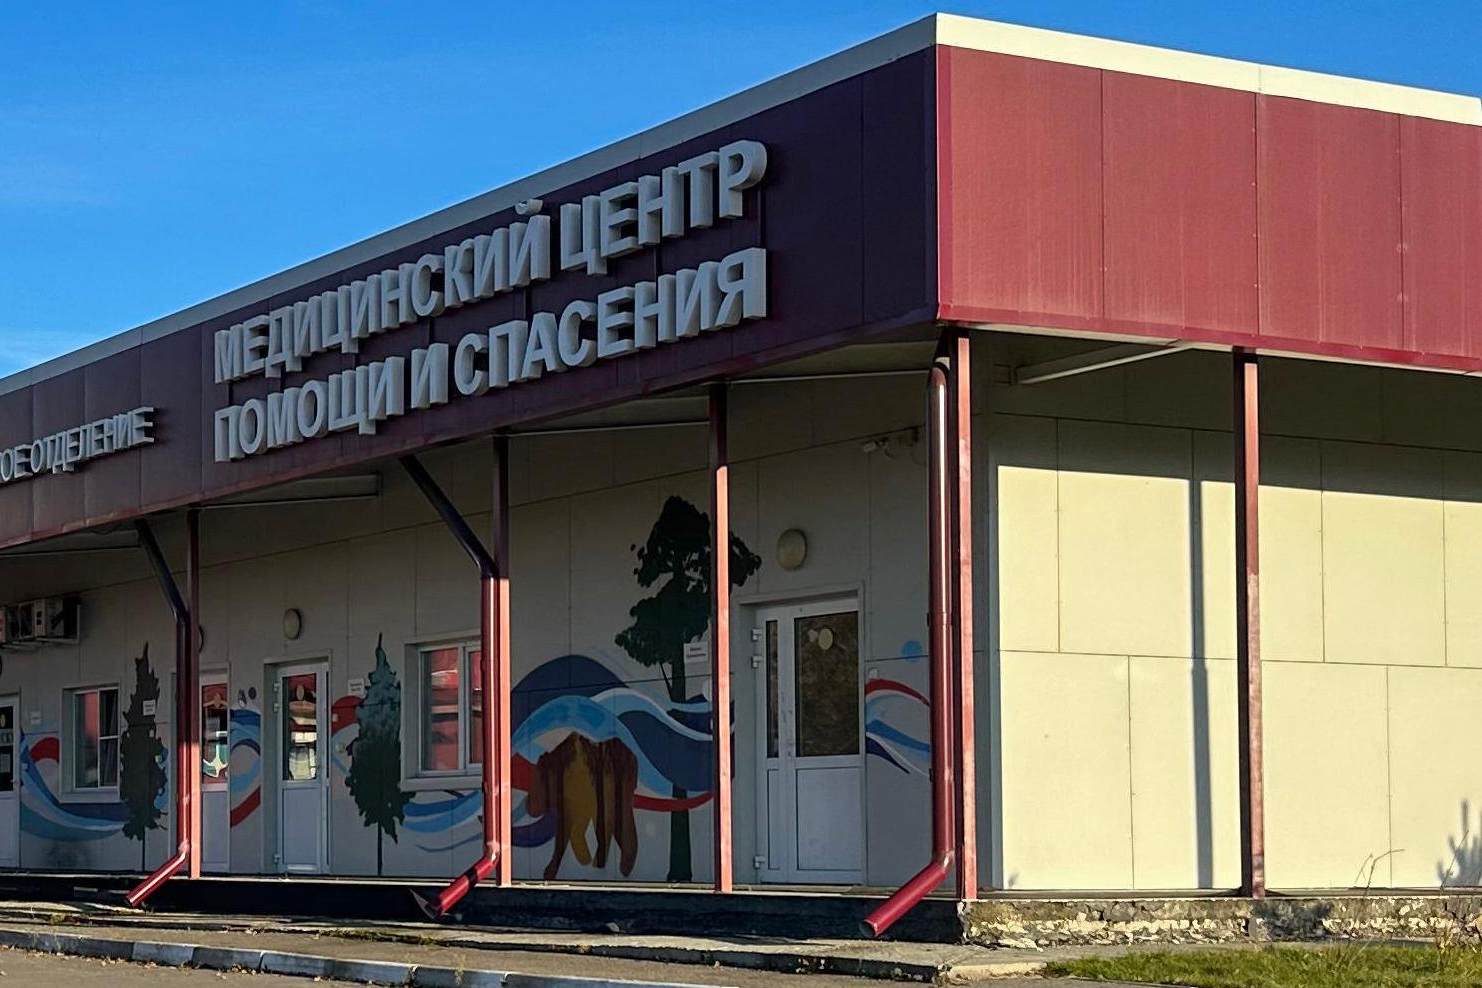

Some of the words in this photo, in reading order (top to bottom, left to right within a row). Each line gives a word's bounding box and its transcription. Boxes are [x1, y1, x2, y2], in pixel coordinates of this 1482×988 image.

[214, 198, 551, 384] МЕДИЦИНСКИЙ
[560, 139, 768, 276] ЦЕНТР
[214, 356, 405, 462] ПОМОЩИ
[411, 342, 449, 409] И
[454, 246, 767, 397] СПАСЕНИЯ
[30, 406, 155, 475] ОТДЕЛЕНИЕ
